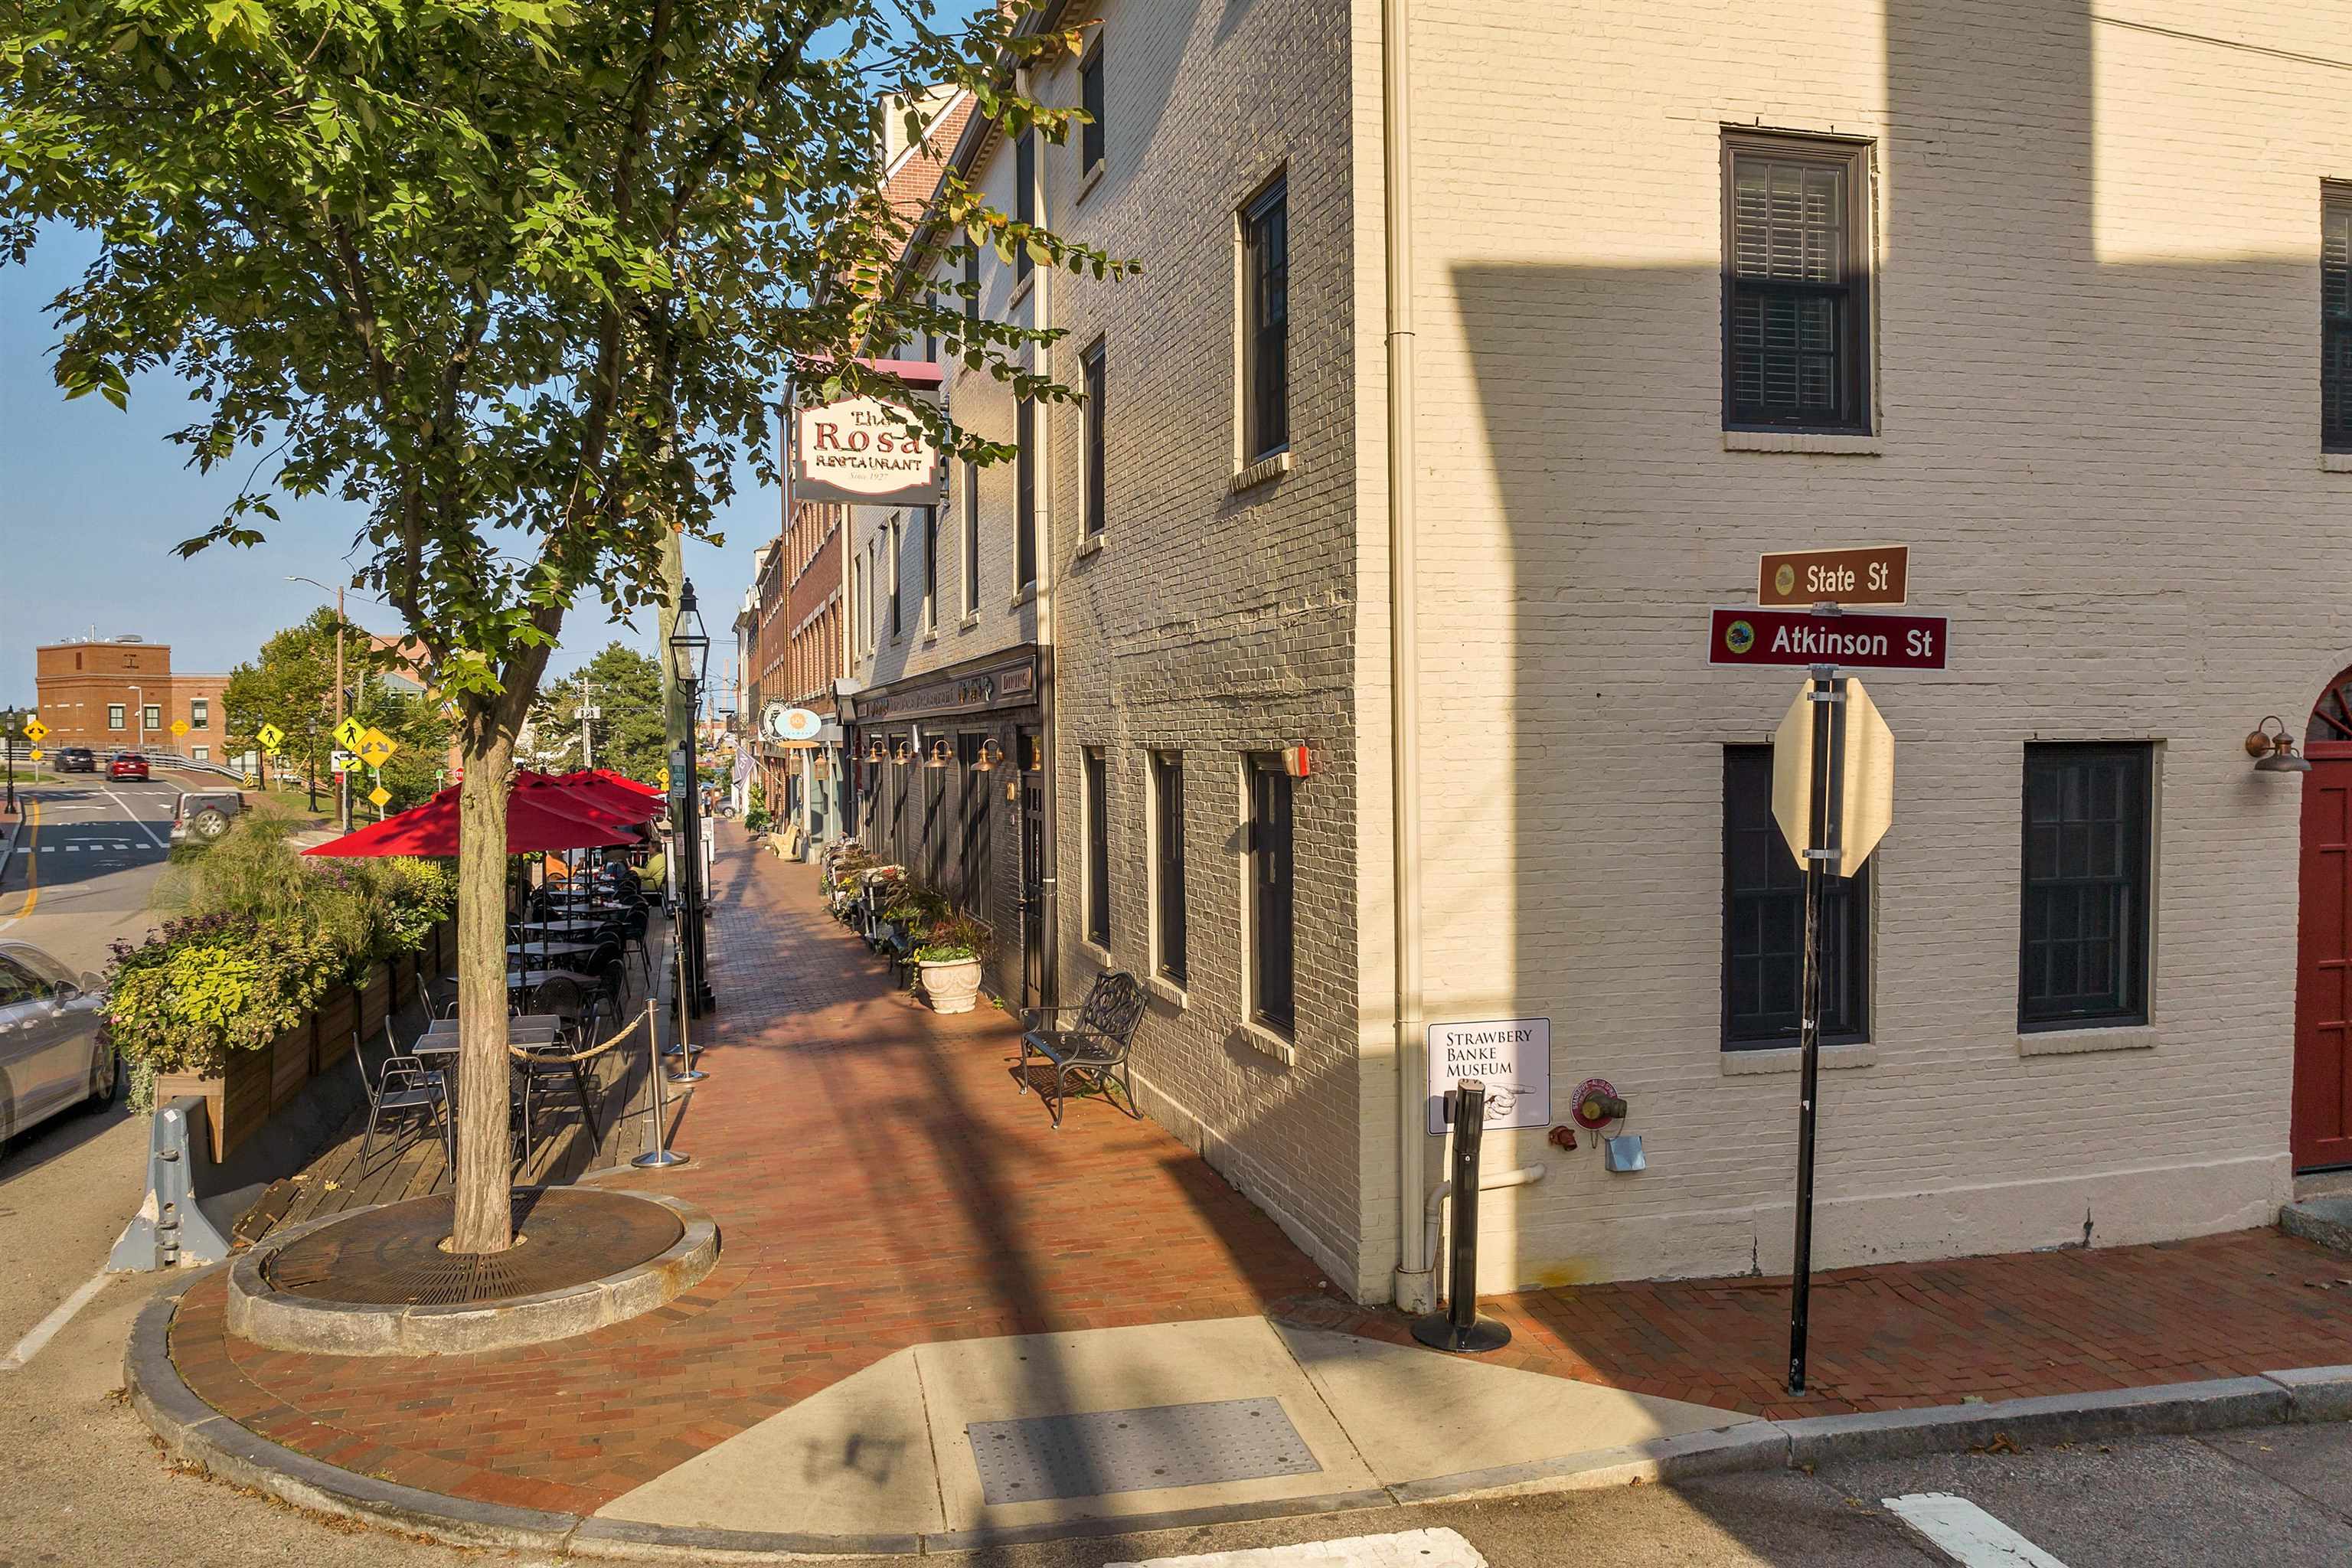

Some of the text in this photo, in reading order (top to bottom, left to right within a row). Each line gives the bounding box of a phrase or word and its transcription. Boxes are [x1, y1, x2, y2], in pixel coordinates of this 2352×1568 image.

[814, 421, 923, 454] Rosa
[815, 456, 922, 472] RESTAURANT
[1806, 562, 1889, 593] State St
[1771, 626, 1933, 657] Atkinson St
[1446, 1029, 1533, 1047] STRAWBERY
[1447, 1047, 1497, 1062] BANKE
[1446, 1062, 1513, 1077] MUSEUM
